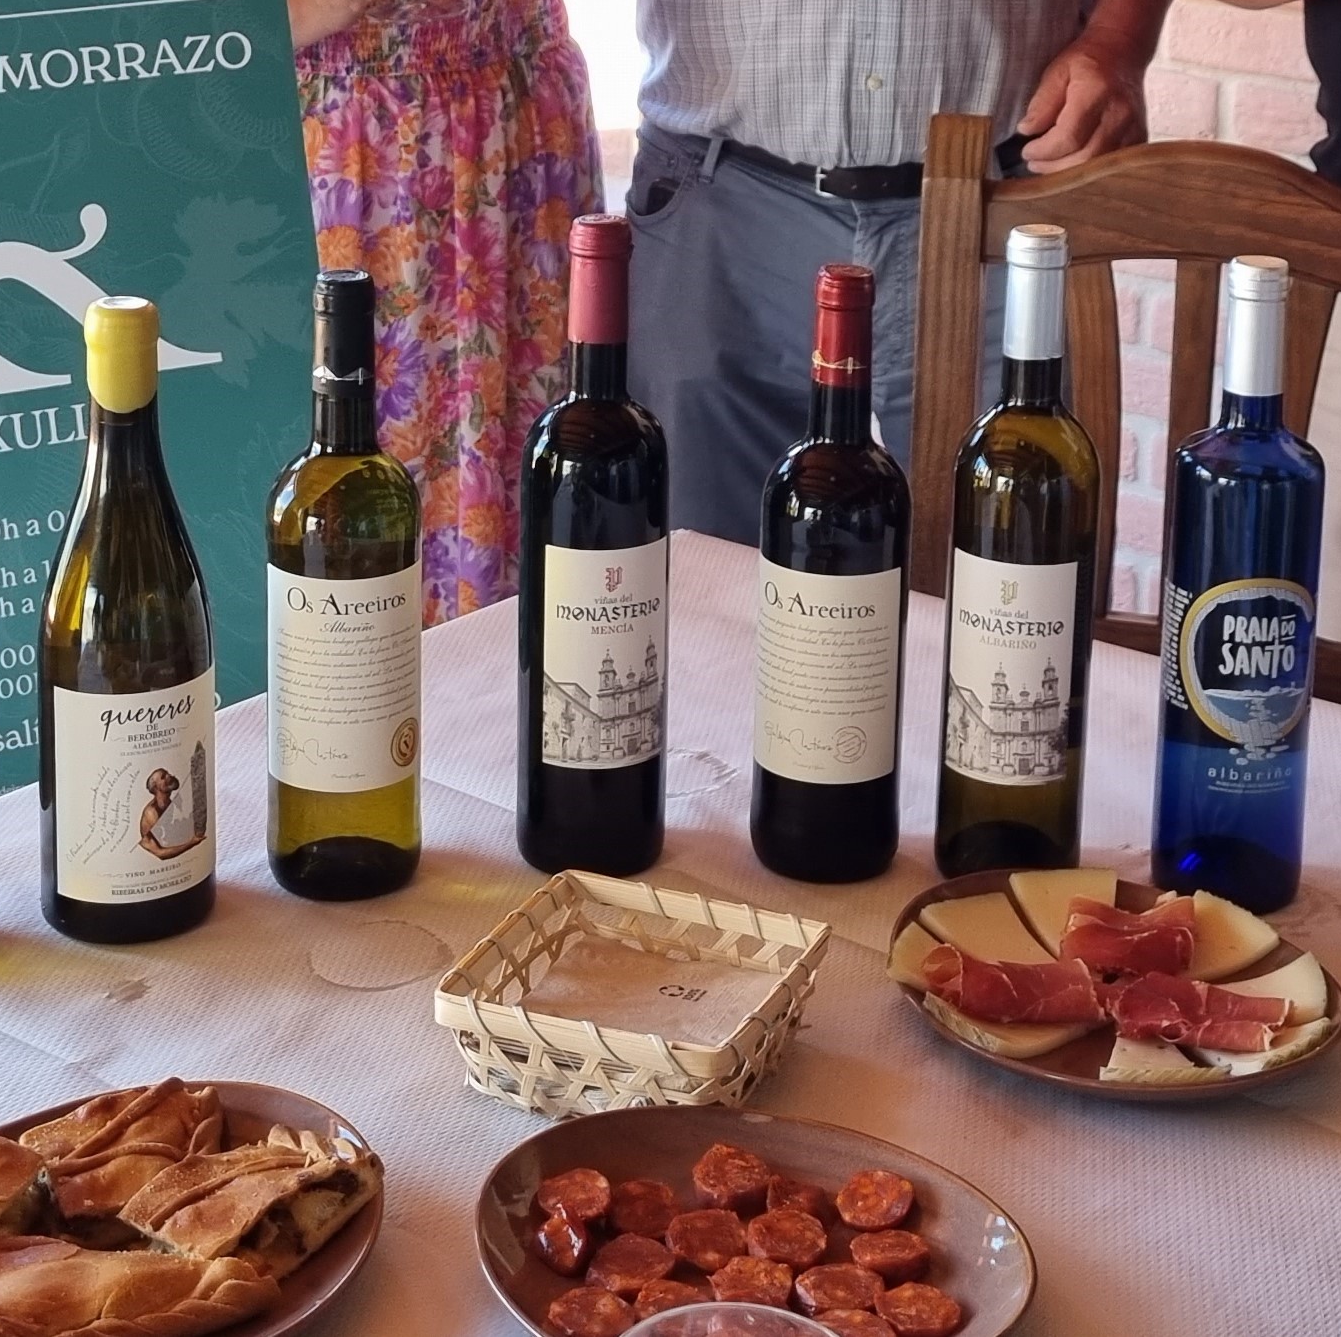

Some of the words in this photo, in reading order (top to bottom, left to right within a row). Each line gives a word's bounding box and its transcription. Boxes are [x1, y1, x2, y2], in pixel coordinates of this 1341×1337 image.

[287, 586, 314, 613] Os
[319, 592, 406, 616] Areeiros
[594, 594, 618, 605] viñas
[619, 592, 633, 602] del
[765, 581, 783, 610] Os
[787, 591, 876, 619] Areeiros
[989, 607, 1013, 619] viñas
[1014, 609, 1029, 620] del
[319, 619, 376, 633] Albariño
[591, 623, 634, 635] MENCÍA
[1222, 614, 1279, 644] PRAIA
[979, 635, 1037, 650] ALBARIÑO
[1218, 639, 1296, 679] SANTO
[100, 695, 195, 742] quereres
[146, 723, 158, 732] DE
[127, 727, 176, 743] BEROBREO
[132, 736, 173, 750] ALBARIÑO
[111, 887, 145, 896] RIBEIRAS
[145, 884, 158, 893] DO
